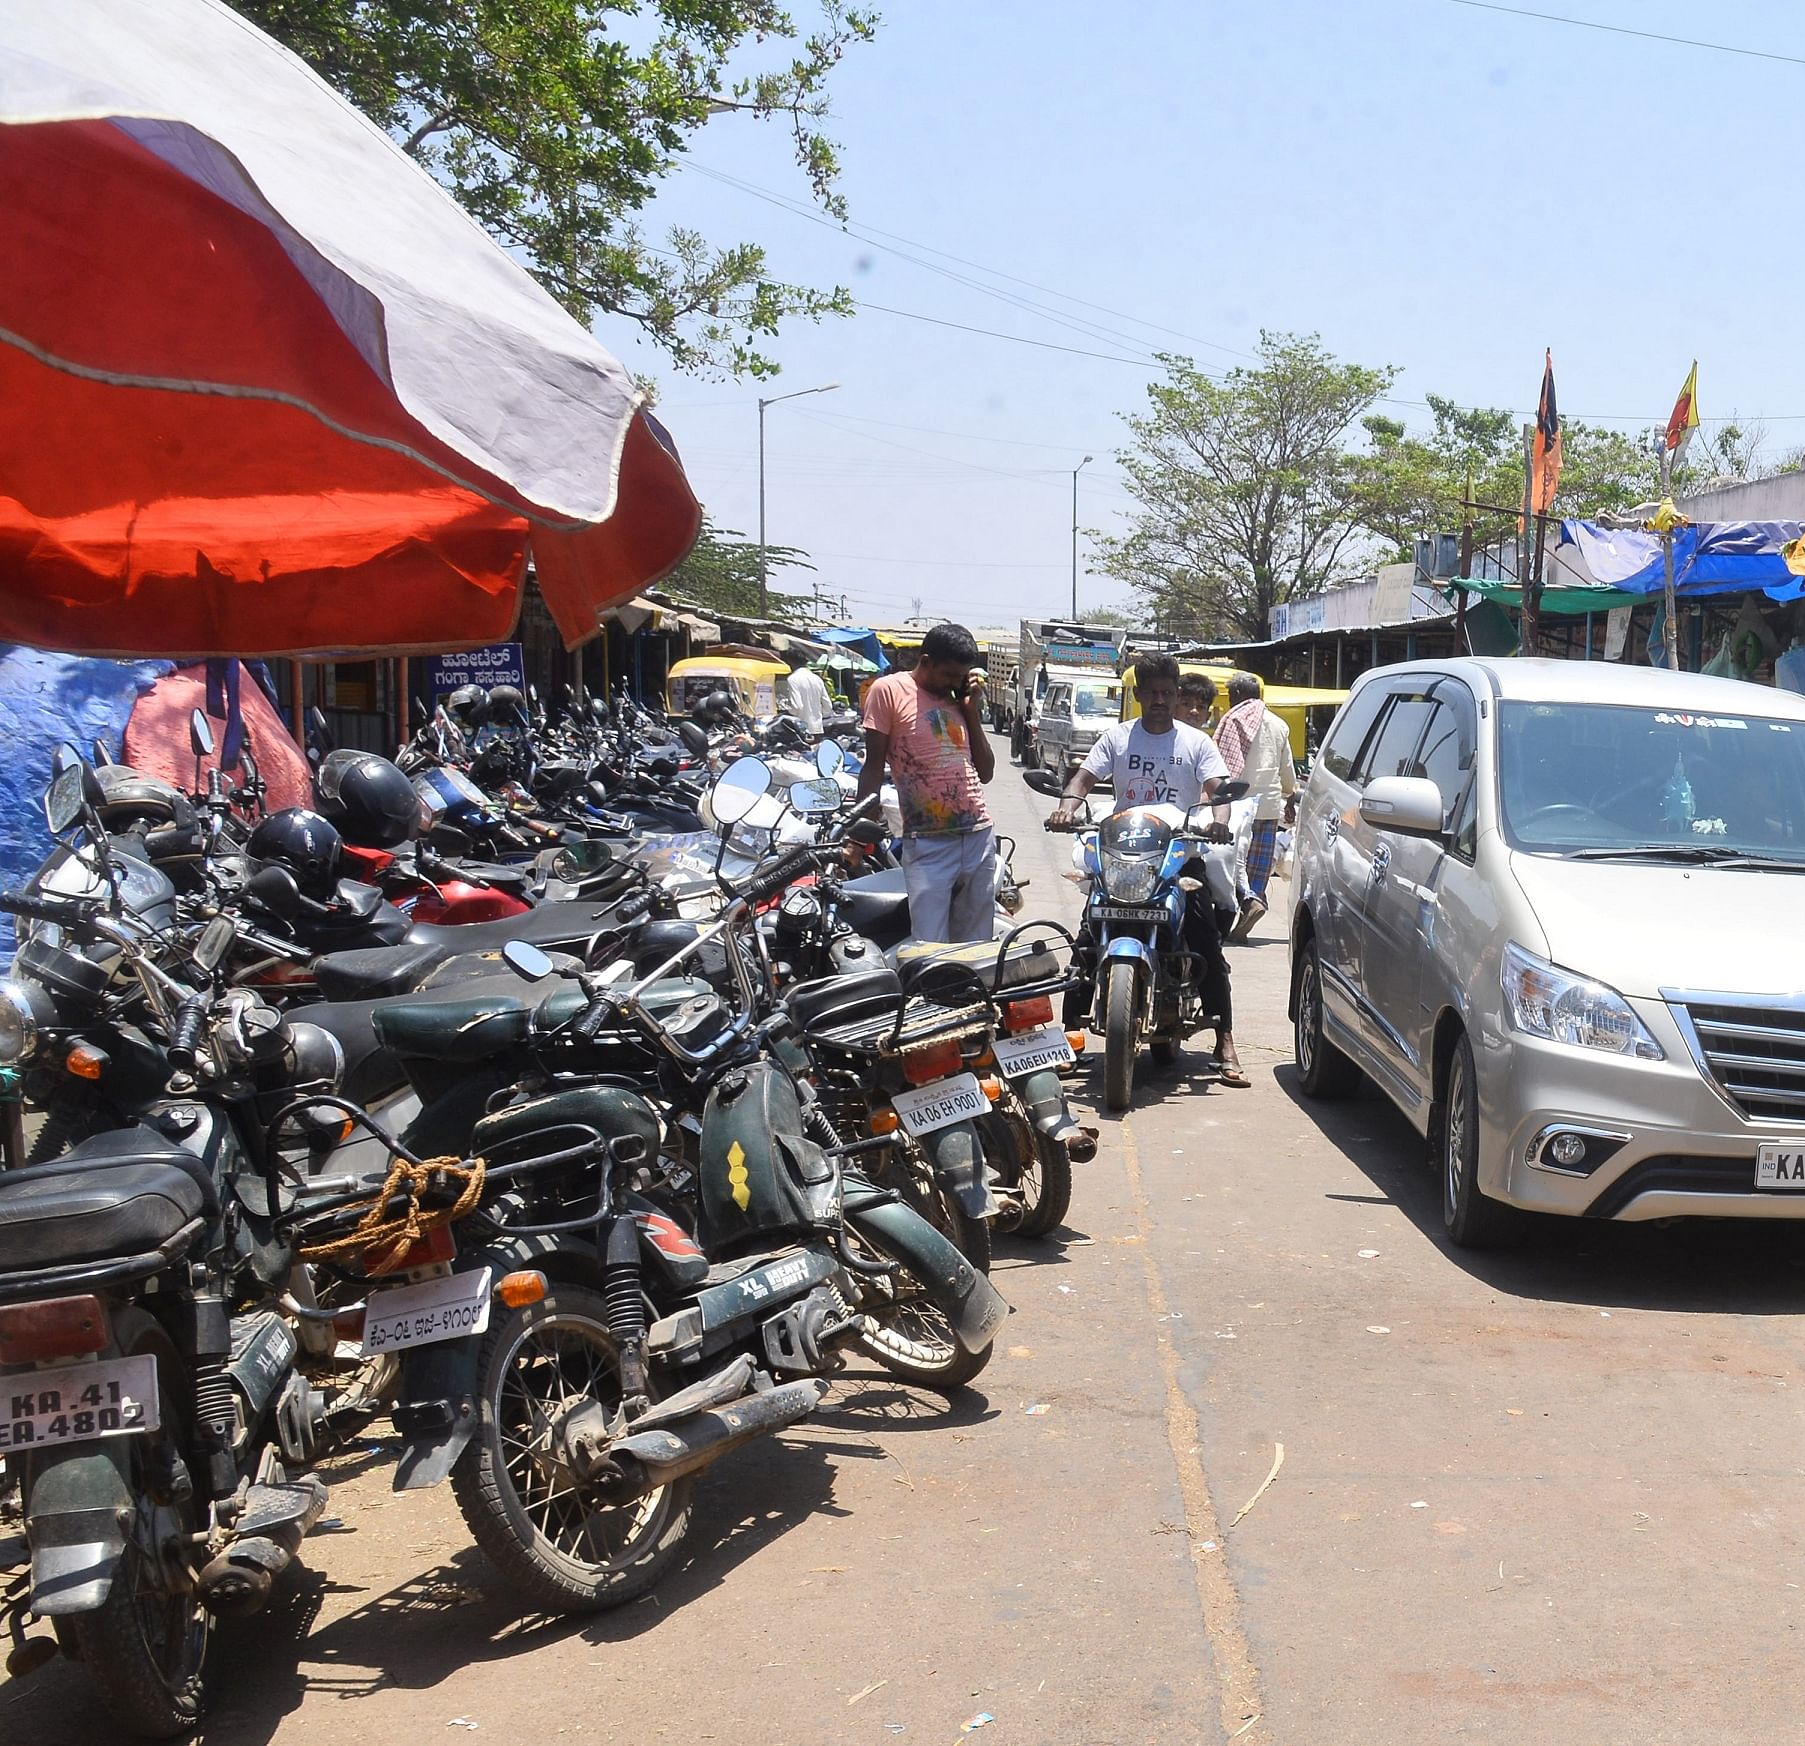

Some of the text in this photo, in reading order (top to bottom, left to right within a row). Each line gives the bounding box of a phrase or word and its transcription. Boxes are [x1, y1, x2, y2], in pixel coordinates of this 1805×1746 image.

[441, 648, 511, 667] ಹೋಟೆಲ್
[435, 670, 469, 685] ಗಂಗಾ
[1101, 907, 1113, 917] KA
[1004, 1048, 1071, 1075] KA06EU1218
[909, 1110, 928, 1128] KA
[925, 1105, 942, 1120] 06
[940, 1100, 957, 1117] EH
[954, 1091, 981, 1112] 9001
[737, 1277, 764, 1296] XL
